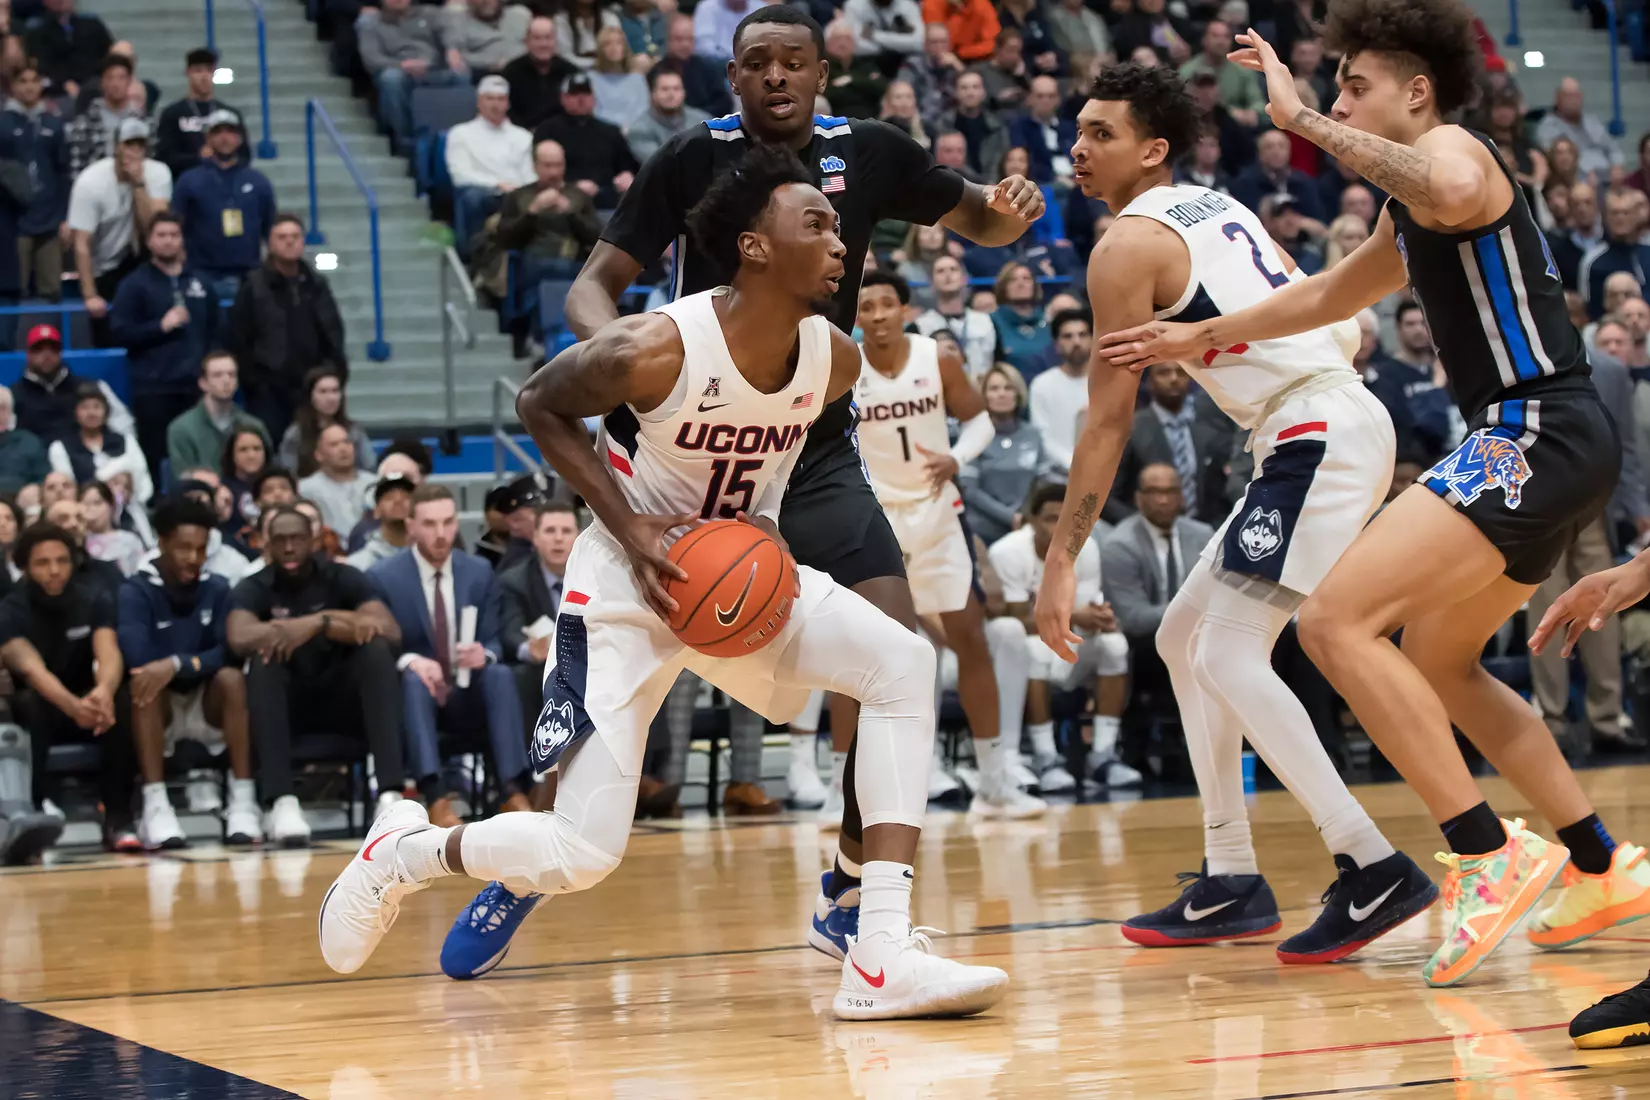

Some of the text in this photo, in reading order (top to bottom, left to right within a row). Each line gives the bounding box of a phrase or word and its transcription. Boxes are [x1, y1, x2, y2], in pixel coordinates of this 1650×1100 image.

[1221, 221, 1290, 290] 2
[674, 421, 813, 454] UCONN
[896, 426, 911, 462] 1
[700, 459, 765, 519] 15
